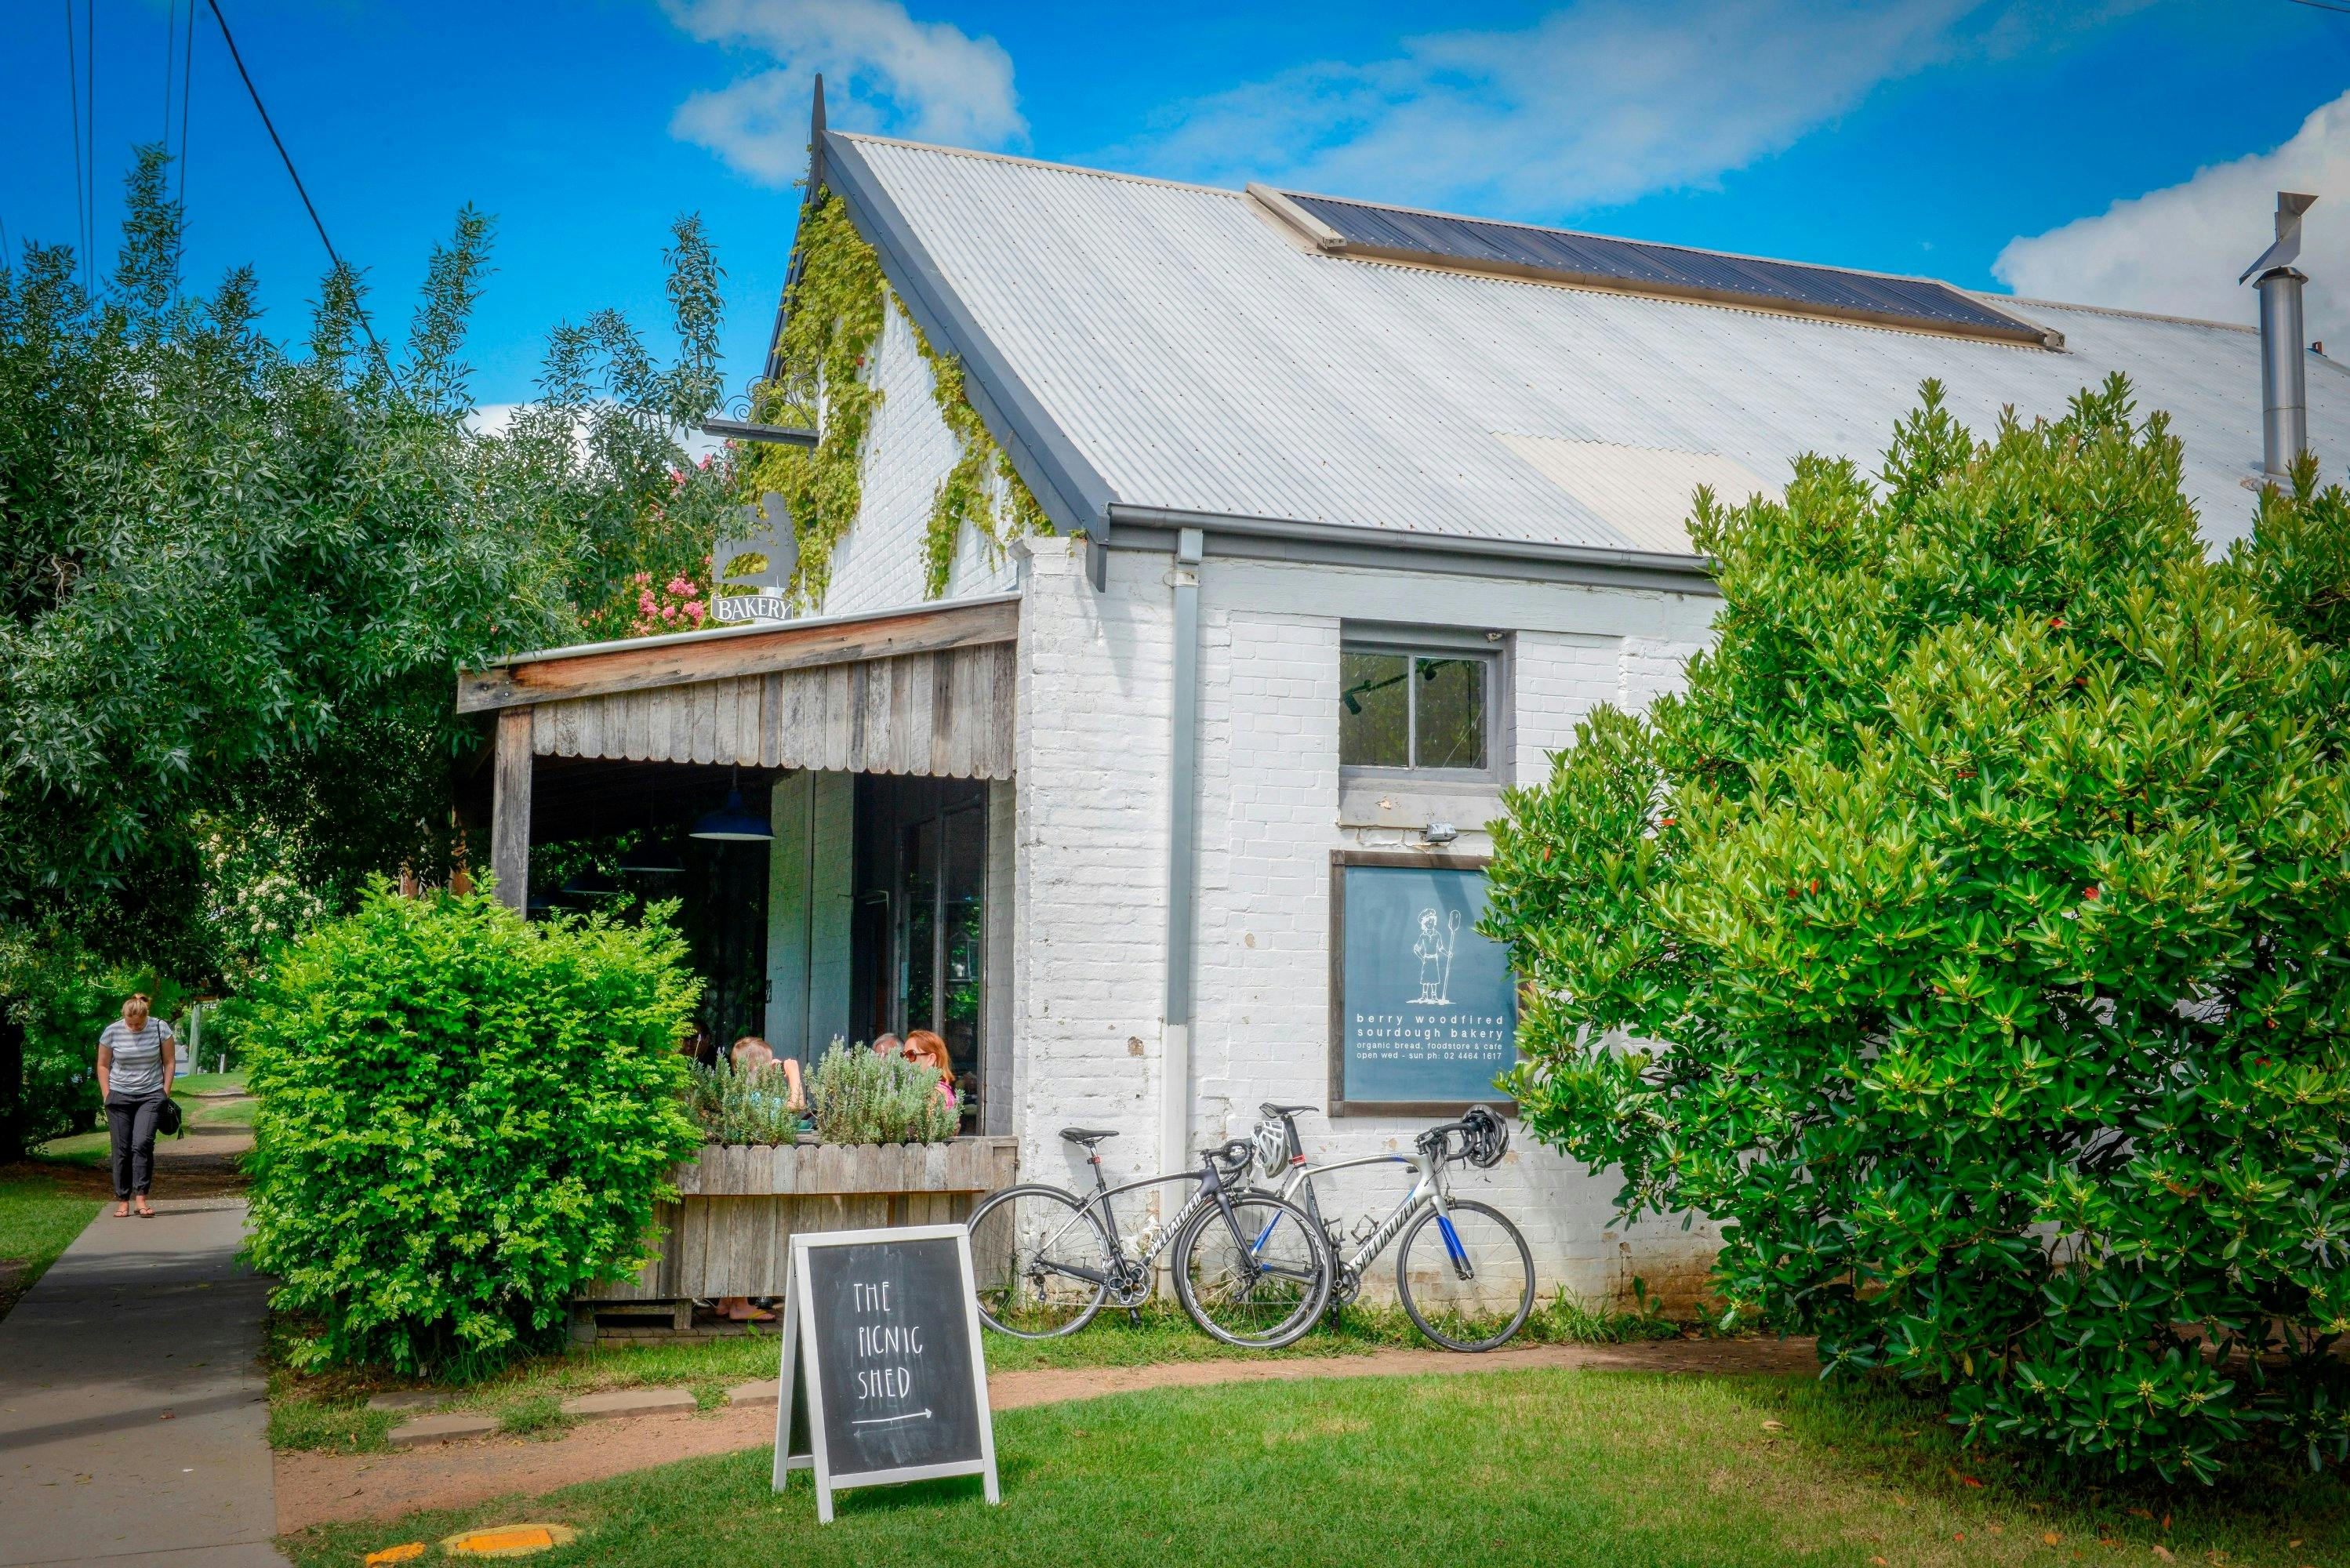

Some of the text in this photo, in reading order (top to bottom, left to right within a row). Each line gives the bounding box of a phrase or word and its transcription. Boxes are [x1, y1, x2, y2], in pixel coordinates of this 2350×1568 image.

[717, 597, 792, 620] BAKERY
[1357, 1014, 1503, 1025] berry woodfired
[1357, 1028, 1503, 1041] sourdough bakery
[1357, 1041, 1390, 1051] organic
[1395, 1042, 1423, 1051] bread,
[1427, 1042, 1470, 1051] foodstore
[1357, 1051, 1378, 1060] open
[1146, 1192, 1201, 1261] SPECIALIZED
[1355, 1196, 1418, 1272] SPECIALIZED
[853, 1281, 892, 1312] THE
[859, 1326, 923, 1358] PICNIC
[858, 1367, 910, 1399] SHED
